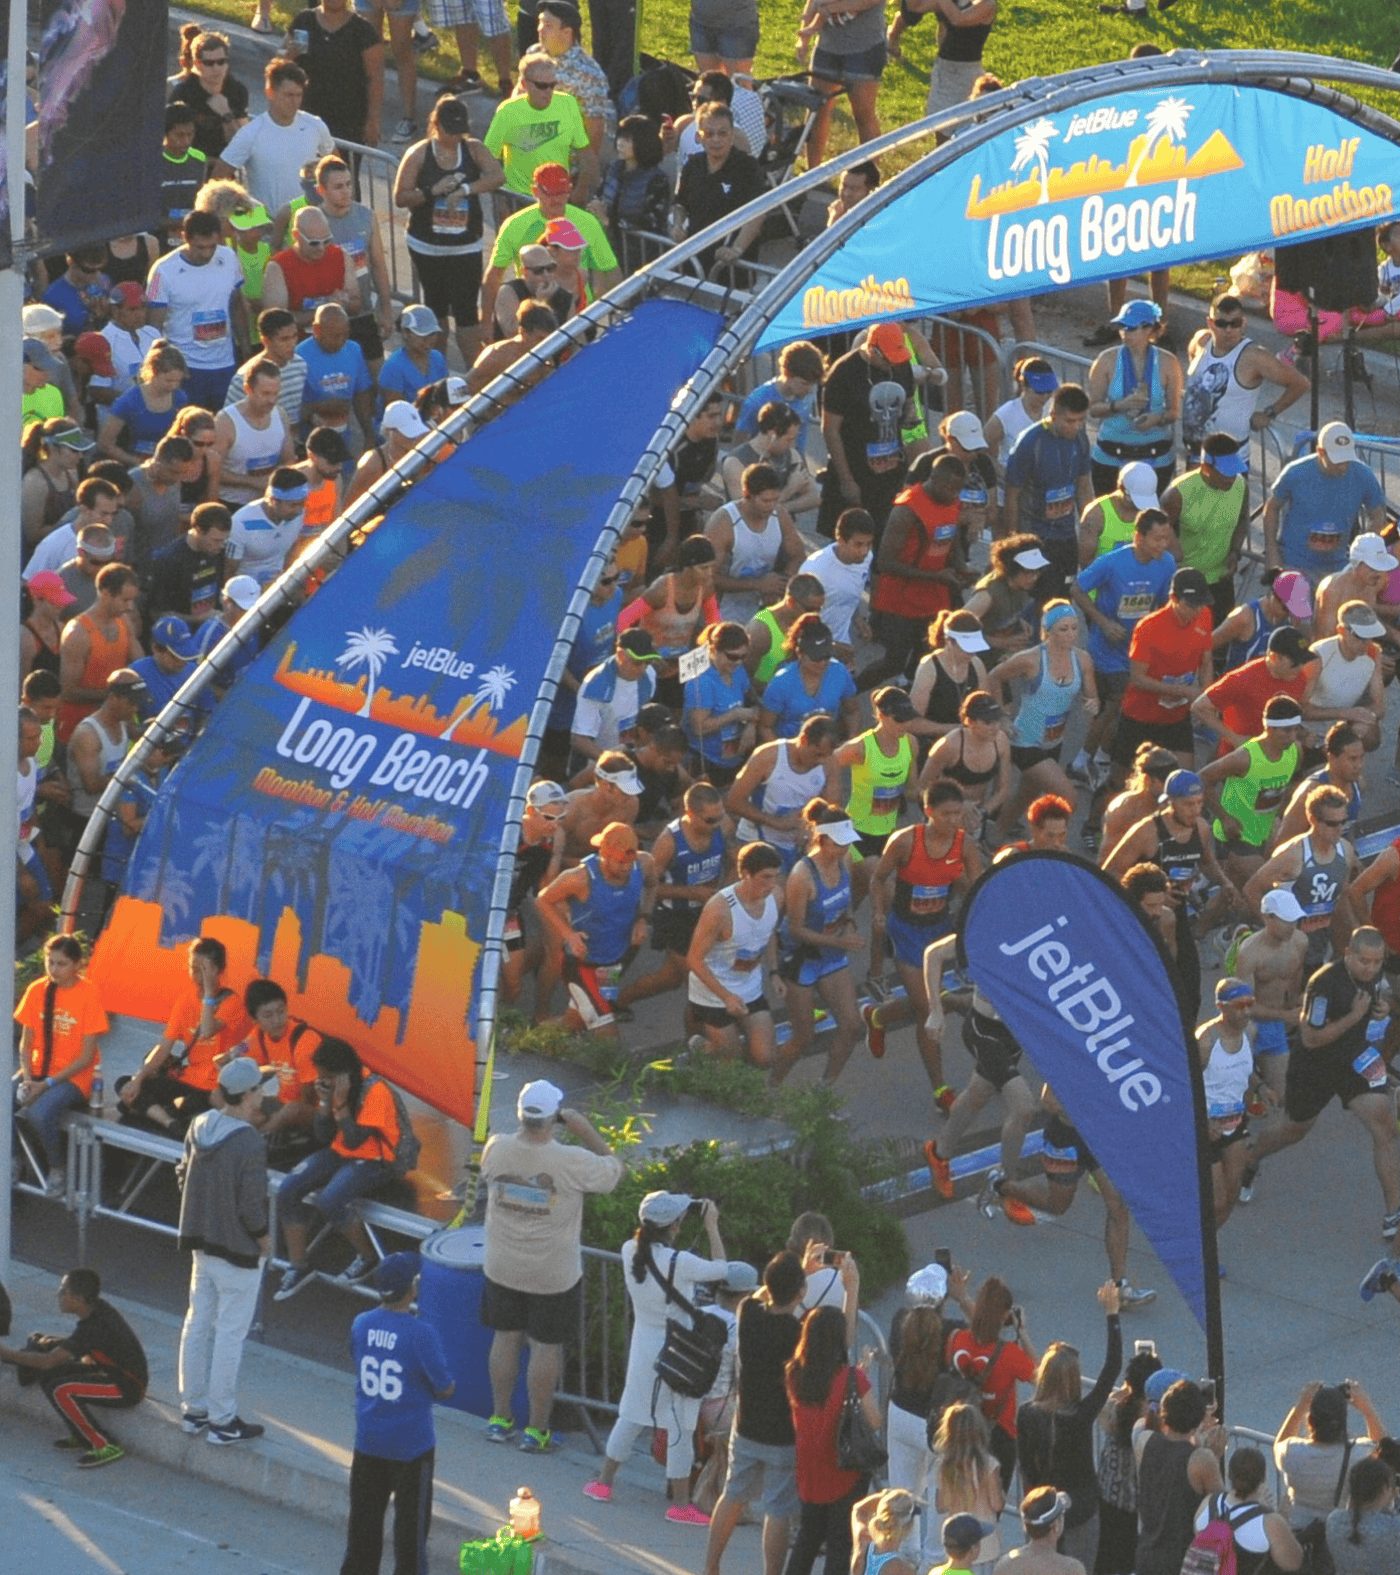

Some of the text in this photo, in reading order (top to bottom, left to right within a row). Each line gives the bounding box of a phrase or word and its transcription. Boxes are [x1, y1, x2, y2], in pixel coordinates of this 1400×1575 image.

[1063, 107, 1141, 143] jetBlue
[1303, 137, 1361, 185] Half
[986, 178, 1197, 284] Long Beach
[1270, 181, 1394, 237] Marathon
[802, 274, 915, 329] Marathon
[401, 640, 475, 680] jetBlue
[276, 696, 489, 810] Long Beach
[254, 766, 333, 809] Marathon
[999, 915, 1163, 1112] jetBlue
[367, 1328, 398, 1351] PUIG
[361, 1355, 403, 1401] 66
